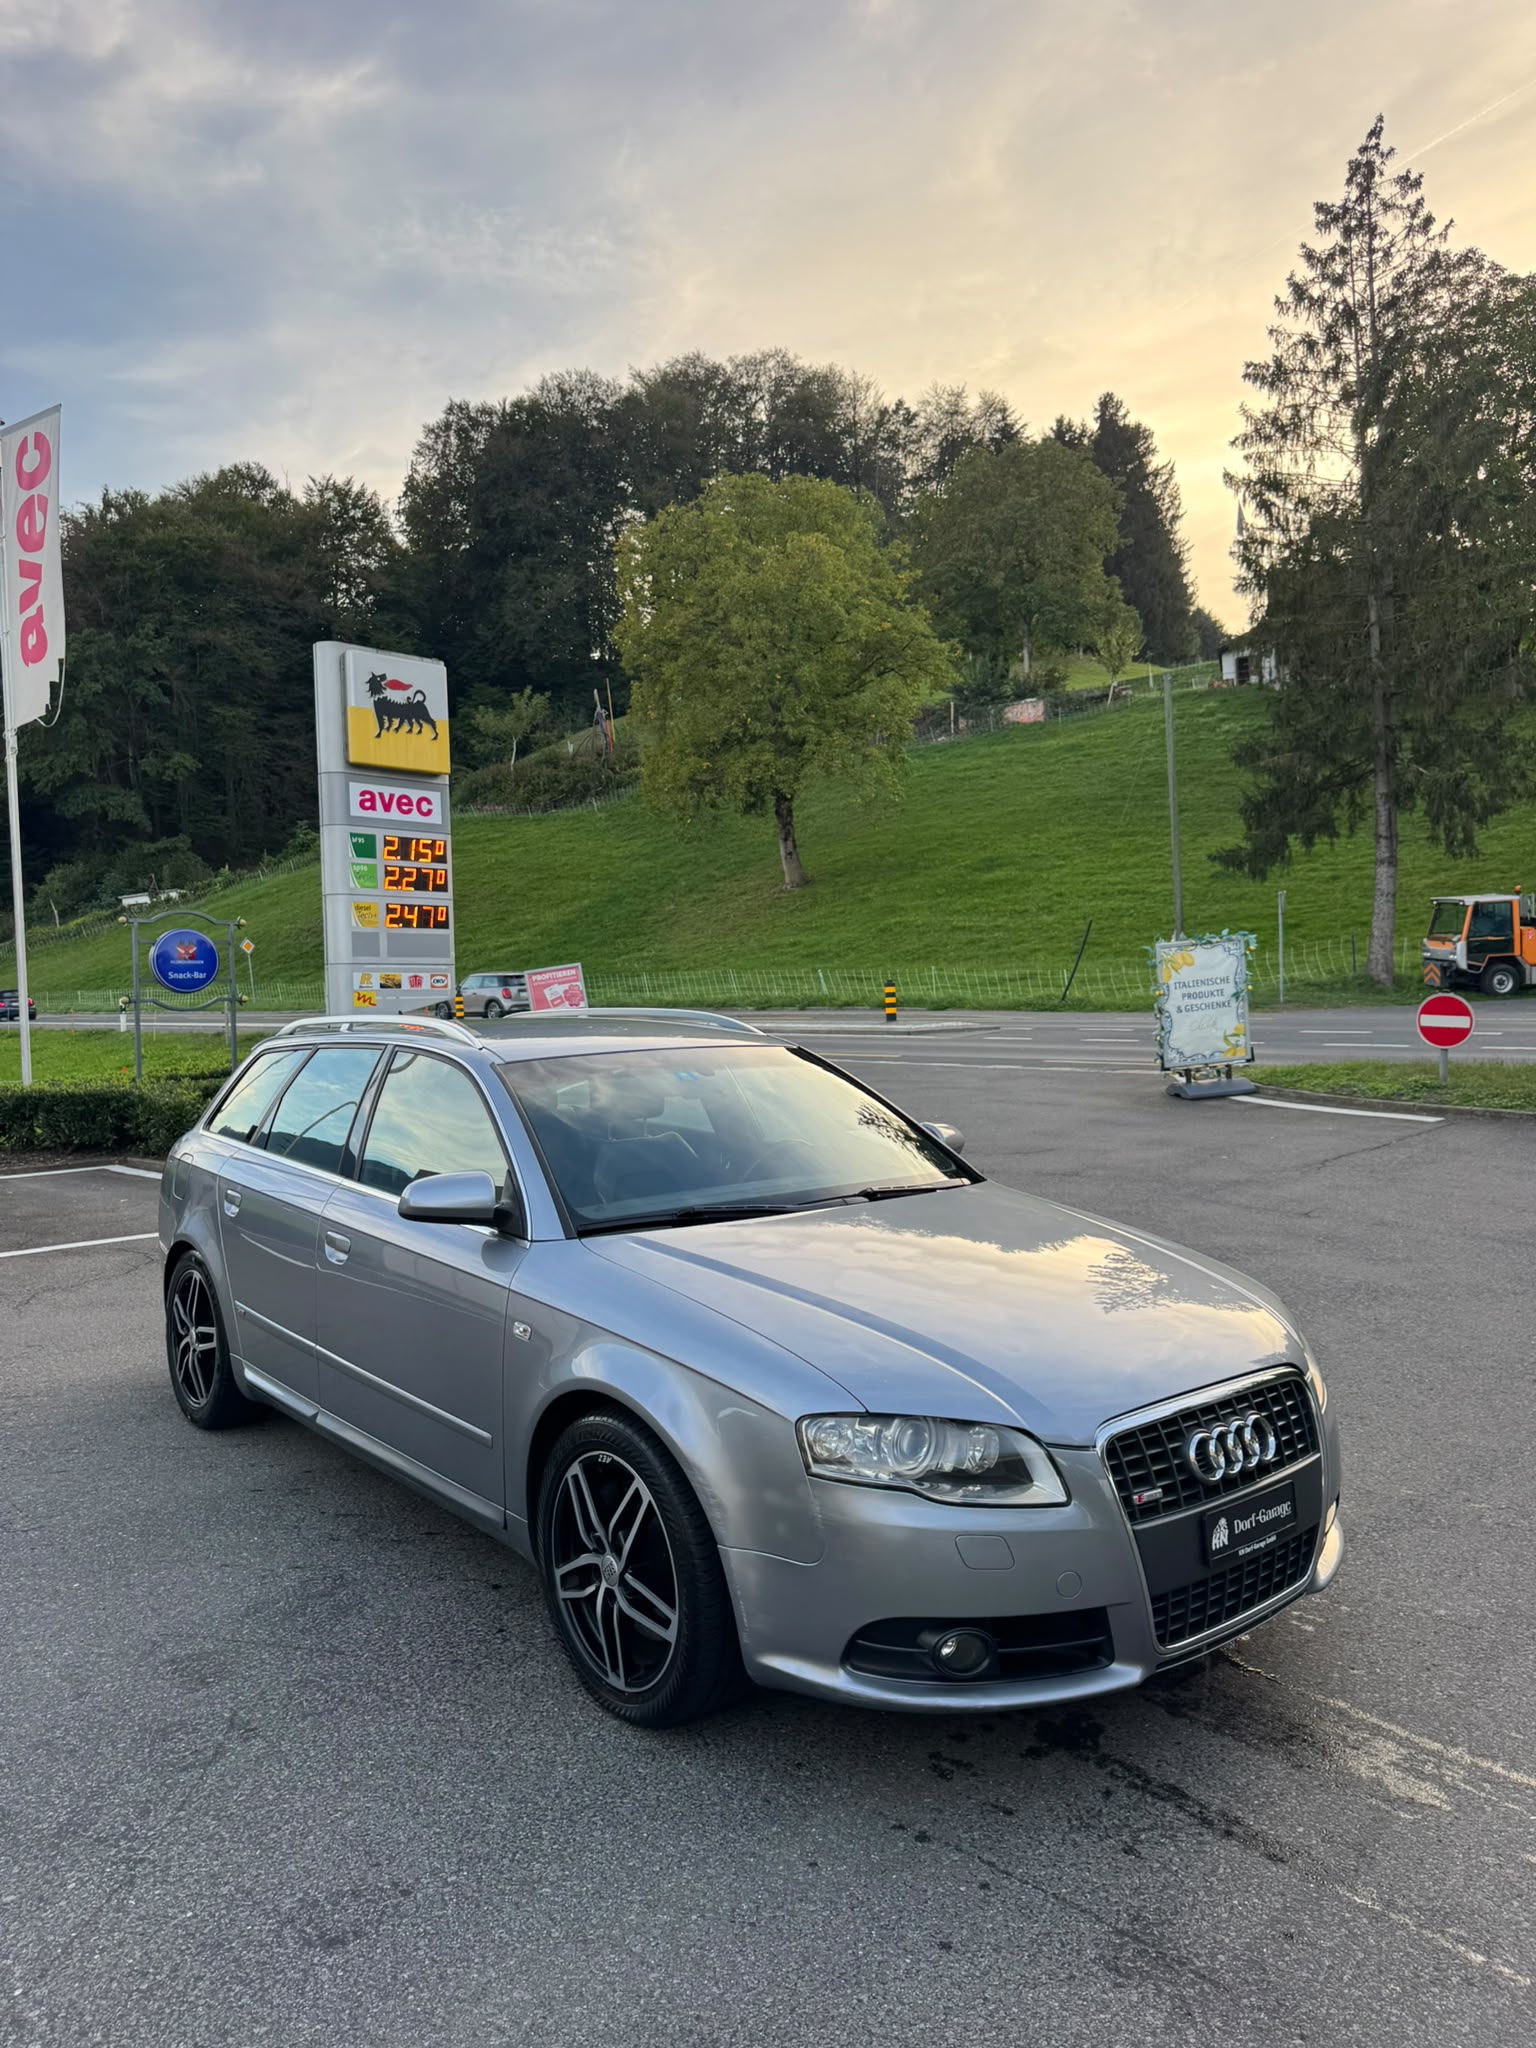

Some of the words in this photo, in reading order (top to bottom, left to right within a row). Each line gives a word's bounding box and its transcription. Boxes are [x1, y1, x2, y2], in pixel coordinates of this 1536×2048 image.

[15, 431, 51, 667] avec
[358, 789, 433, 817] avec
[168, 971, 207, 980] Snack-Bar
[1174, 976, 1231, 990] ITALIENISCHE
[1182, 988, 1225, 1001] PRODUKTE
[1176, 1006, 1183, 1014] &
[1184, 1000, 1232, 1013] GESCHENKE
